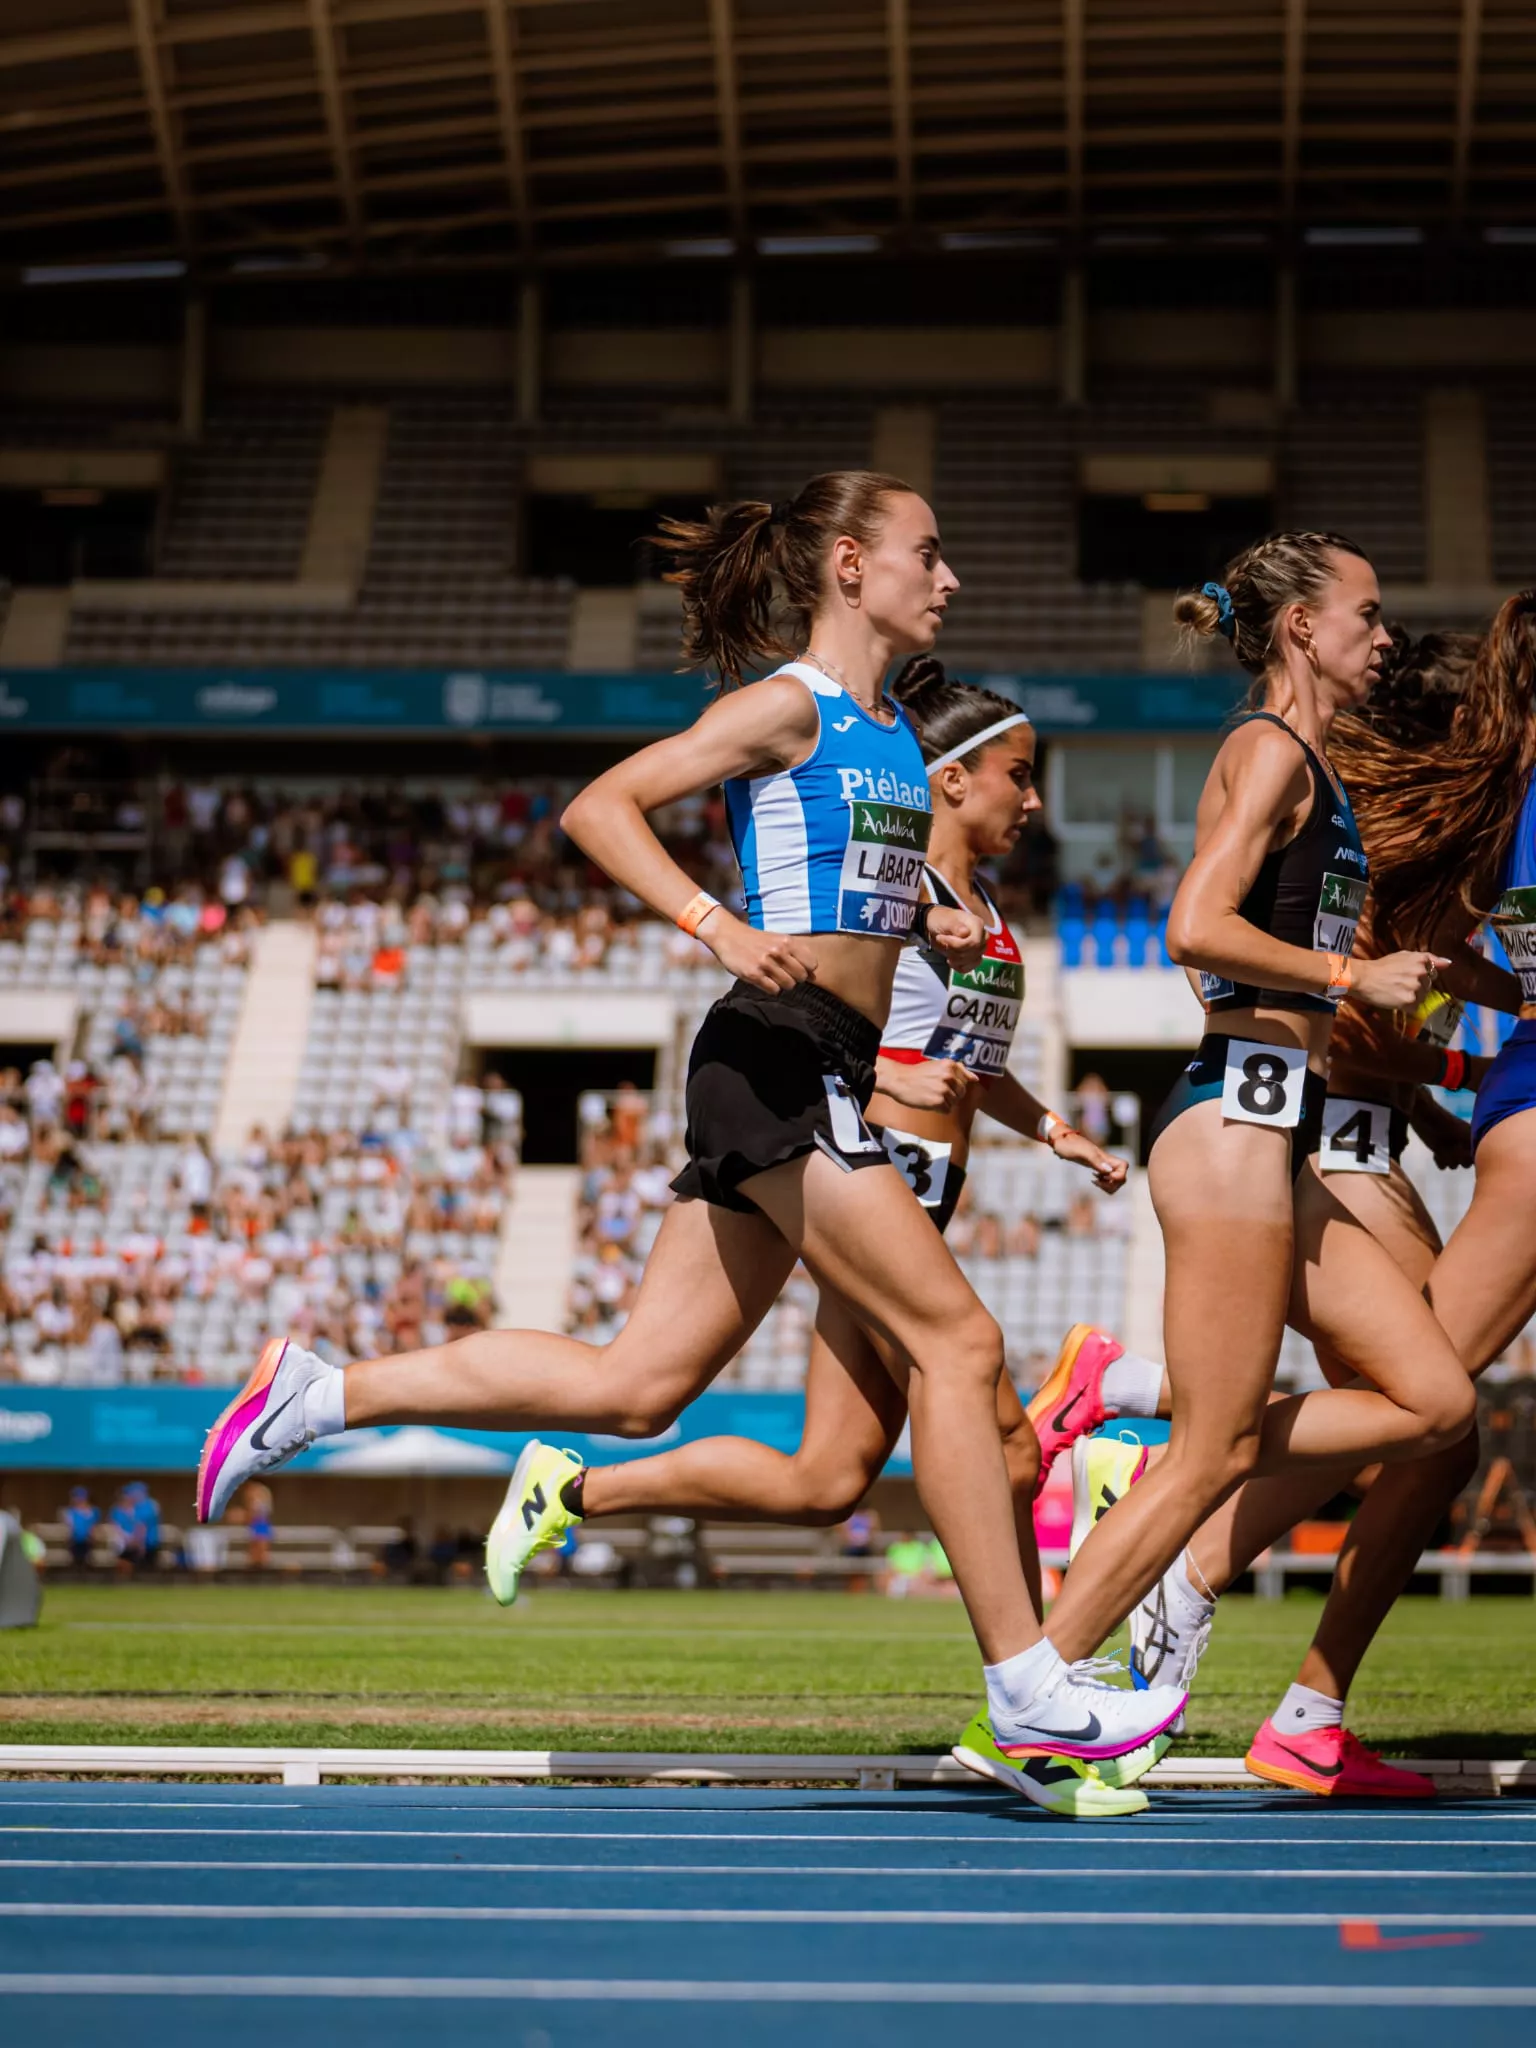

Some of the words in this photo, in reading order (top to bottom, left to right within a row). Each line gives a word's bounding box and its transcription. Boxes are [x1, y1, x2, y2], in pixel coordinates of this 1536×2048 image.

[1237, 1052, 1289, 1116] 8
[1330, 1108, 1376, 1165] 4
[893, 1142, 933, 1198] 3
